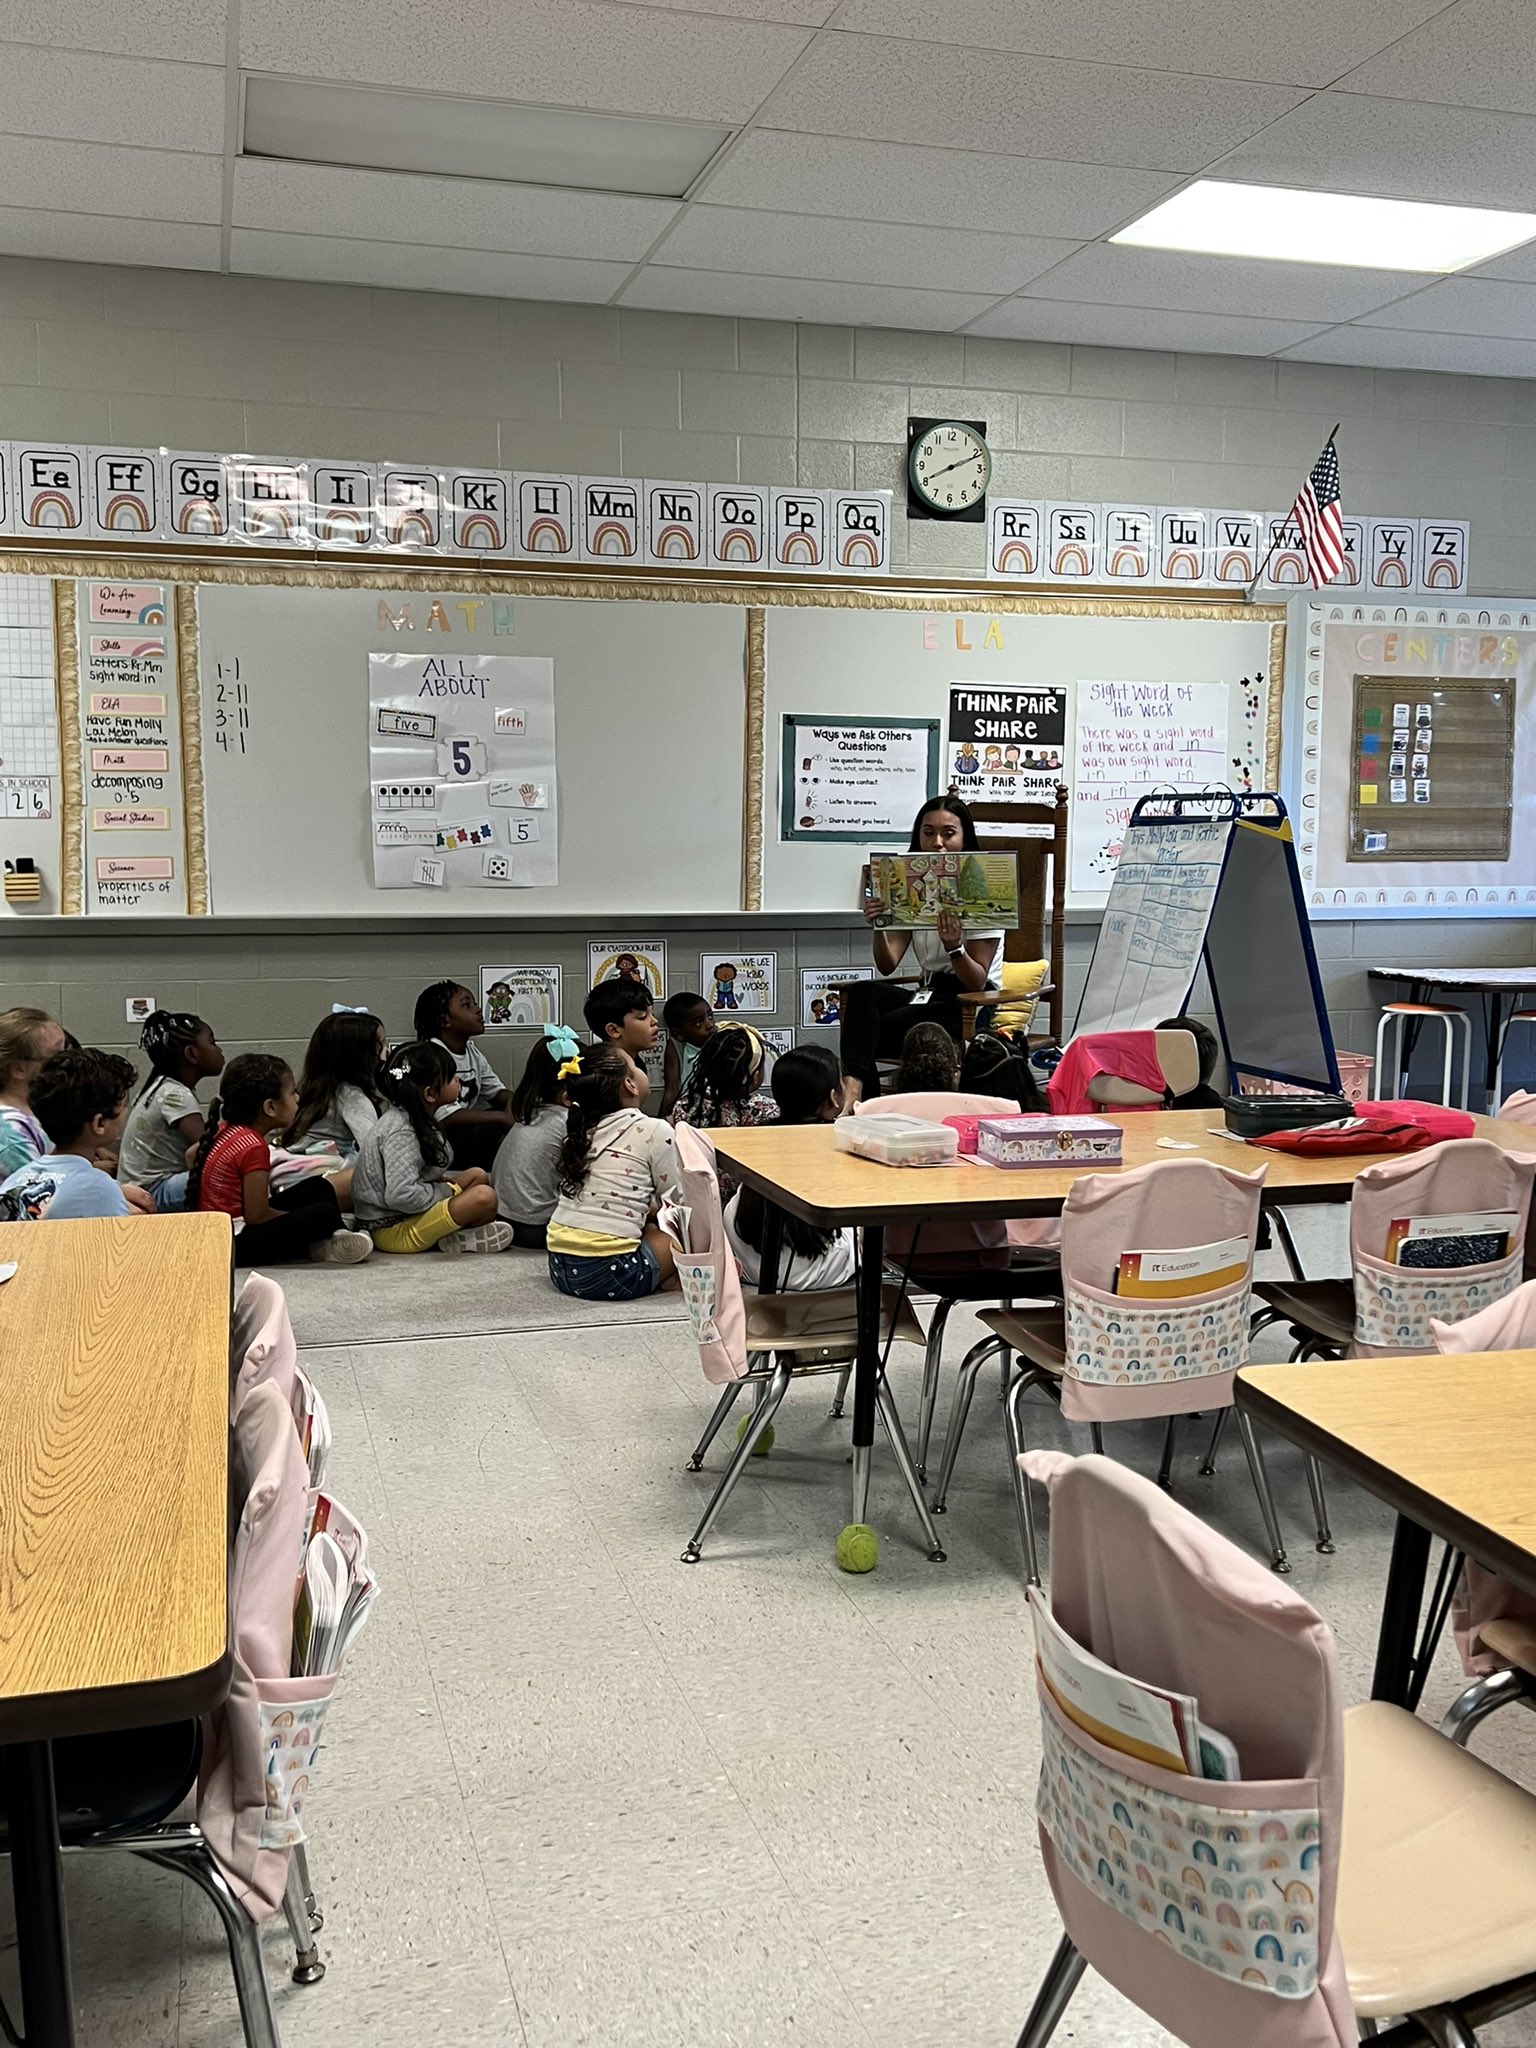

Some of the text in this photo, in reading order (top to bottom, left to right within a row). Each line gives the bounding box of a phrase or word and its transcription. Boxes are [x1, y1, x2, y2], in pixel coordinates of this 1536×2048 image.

[936, 435, 941, 444] 11
[948, 432, 956, 441] 12
[924, 446, 932, 456] 10
[973, 448, 979, 458] 2
[919, 461, 925, 470] 9
[977, 464, 983, 474] 3
[922, 477, 928, 486] 8
[971, 480, 977, 488] 4
[31, 459, 881, 537] Ee Ff Gg Hh Ii Jj Kk Ll Mm Nn Oo Pp Qq
[933, 488, 939, 498] 7
[946, 494, 952, 503] 6
[961, 490, 967, 500] 5
[1003, 512, 1030, 537] Rr
[1059, 516, 1086, 540] Ss
[1117, 518, 1141, 541] Tt
[1169, 520, 1197, 544] Uu
[1224, 524, 1250, 546] Vv
[1381, 531, 1405, 559] Yy
[1432, 532, 1456, 555] Zz
[377, 599, 515, 635] MATH
[923, 619, 1006, 650] ELA
[100, 639, 121, 650] Skills
[1355, 632, 1519, 667] CENTERS
[422, 658, 476, 679] ALL
[144, 674, 156, 684] in
[418, 677, 490, 699] ABOUT
[1090, 683, 1128, 705] Sight
[1177, 684, 1193, 701] of
[101, 697, 120, 710] ELA
[1112, 702, 1133, 718] the
[86, 715, 162, 734] Have Fun Molly
[394, 713, 420, 732] five
[497, 715, 524, 728] fifth
[108, 727, 138, 737] Melon
[812, 729, 840, 742] Ways
[859, 729, 876, 740] Ask
[878, 730, 912, 741] Others
[1082, 725, 1215, 743] There was a sight word
[837, 741, 887, 751] Questions
[1082, 739, 1201, 753] of the week and in
[103, 755, 126, 765] Math
[451, 741, 472, 775] 5
[1082, 757, 1105, 768] was
[1108, 757, 1127, 767] our
[1130, 755, 1159, 769] sight
[8, 779, 16, 787] IN
[19, 779, 48, 789] SCHOOL
[91, 773, 164, 792] decomposing
[33, 793, 44, 810] 6
[1076, 790, 1100, 802] and
[103, 812, 155, 824] Social Studies
[517, 824, 529, 841] 5
[107, 862, 136, 874] Science
[158, 881, 171, 893] of
[98, 894, 141, 906] matter
[592, 944, 662, 953] OUR CLASSROOM RULES
[740, 957, 770, 967] WE USE
[741, 981, 769, 991] WORDS
[1426, 1226, 1463, 1235] Education
[1161, 1261, 1200, 1272] Education
